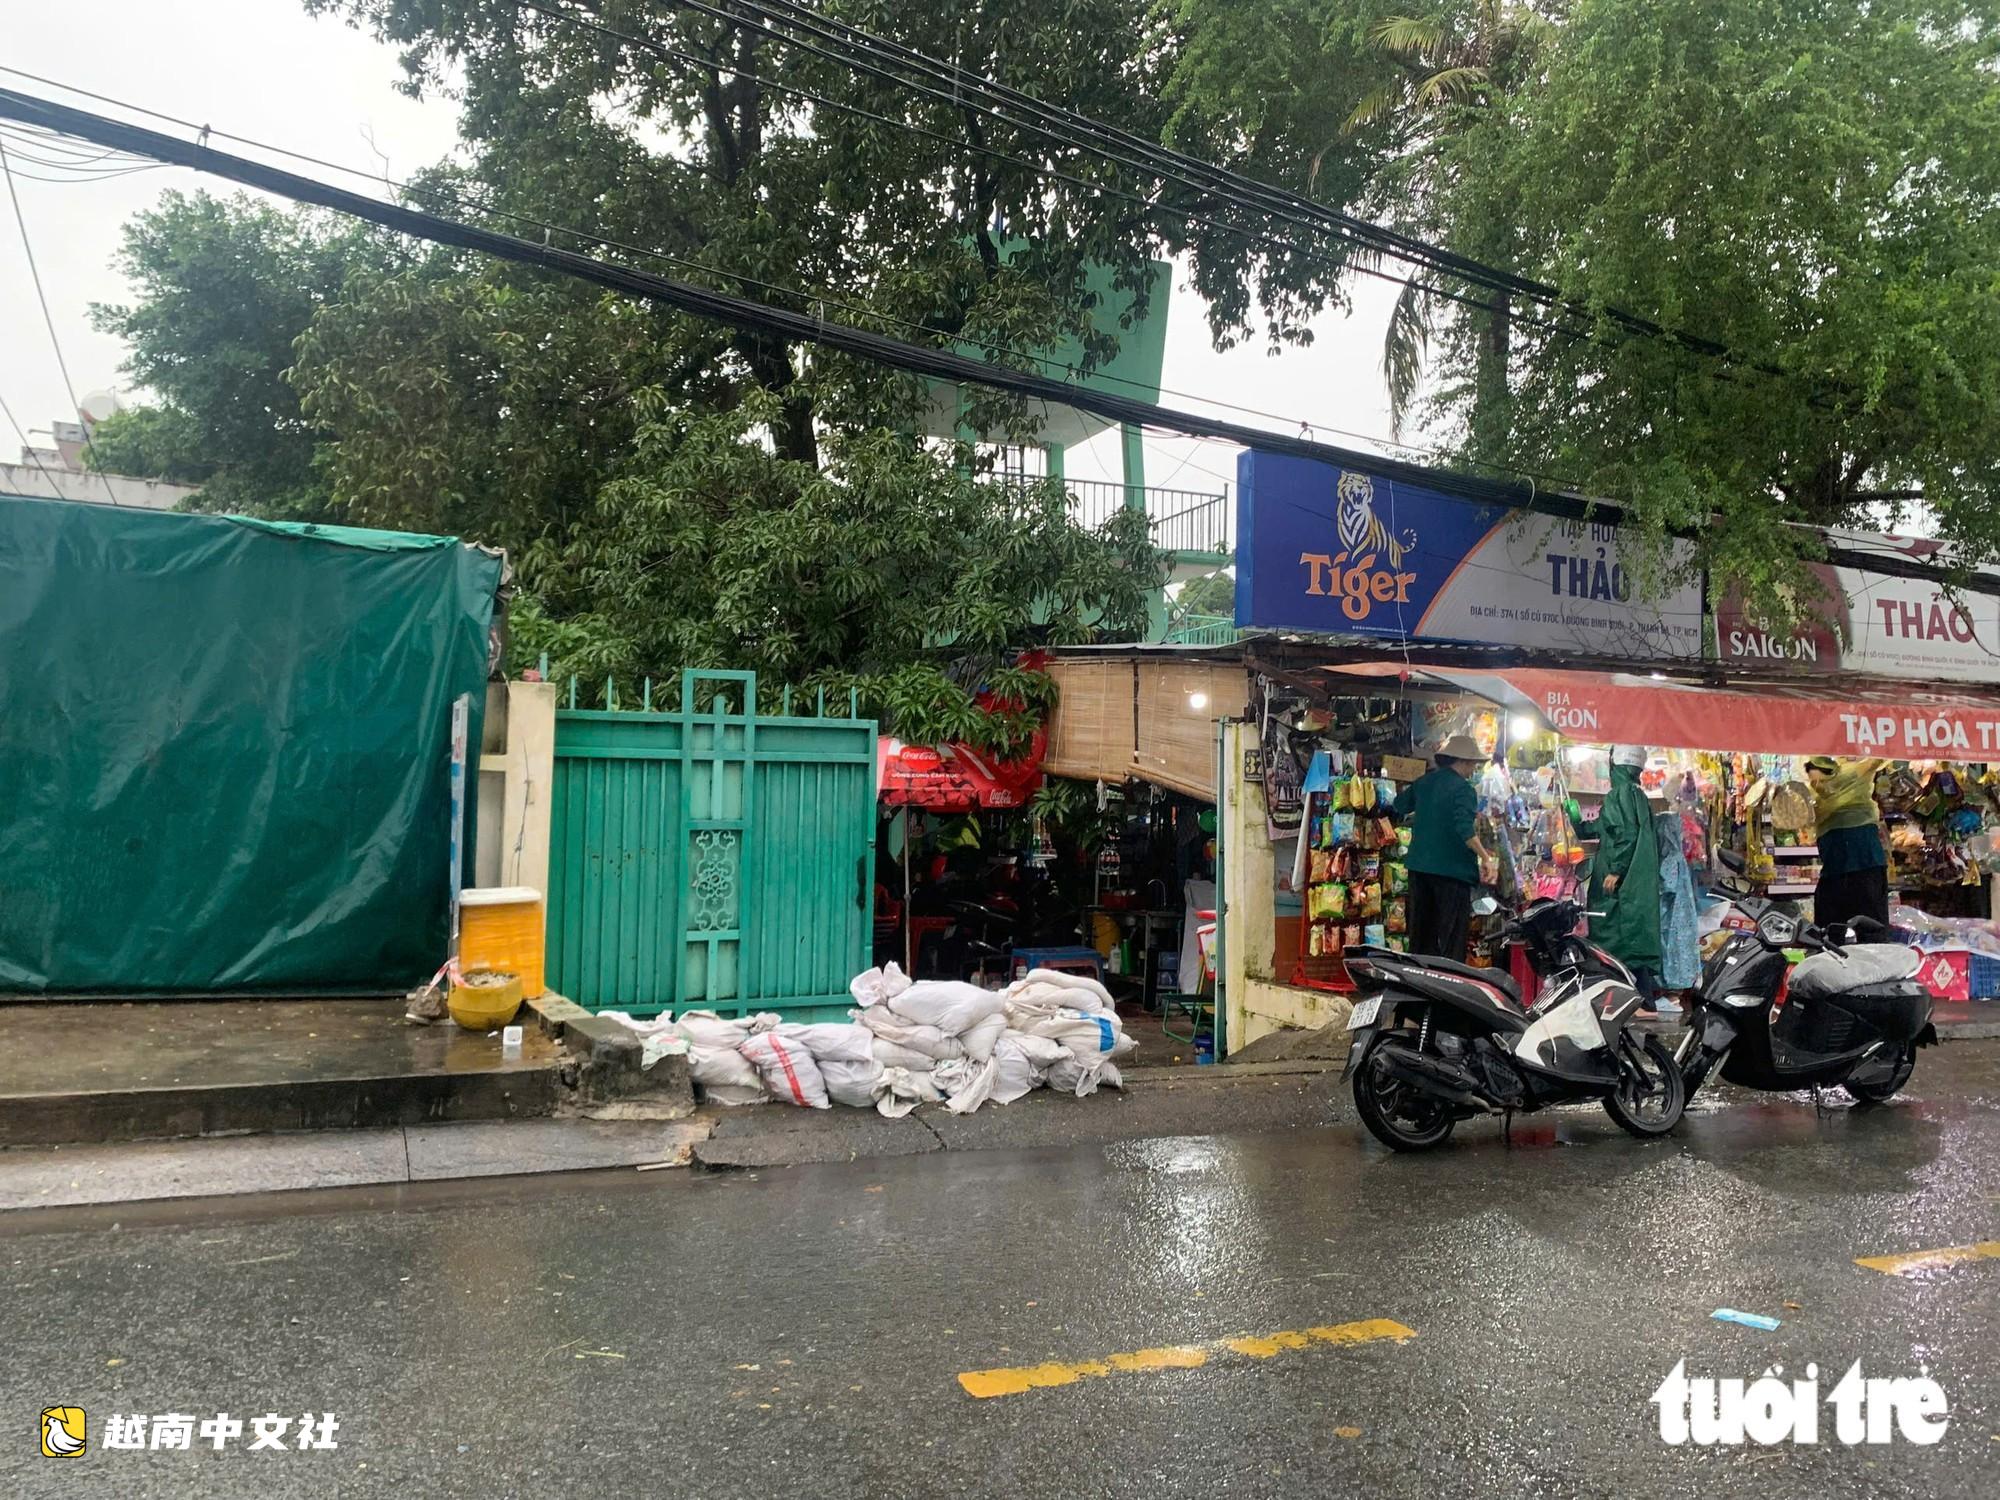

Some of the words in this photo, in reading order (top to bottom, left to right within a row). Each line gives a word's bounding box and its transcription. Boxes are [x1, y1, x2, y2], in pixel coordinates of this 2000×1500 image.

[1300, 551, 1417, 620] Tiger
[1546, 547, 1631, 602] THẢO
[1876, 592, 1975, 643] THẢO
[1729, 631, 1817, 662] SAIGON
[1547, 691, 1571, 706] BIA
[1839, 713, 1897, 754] TẠP
[1903, 711, 1970, 750] HÓA
